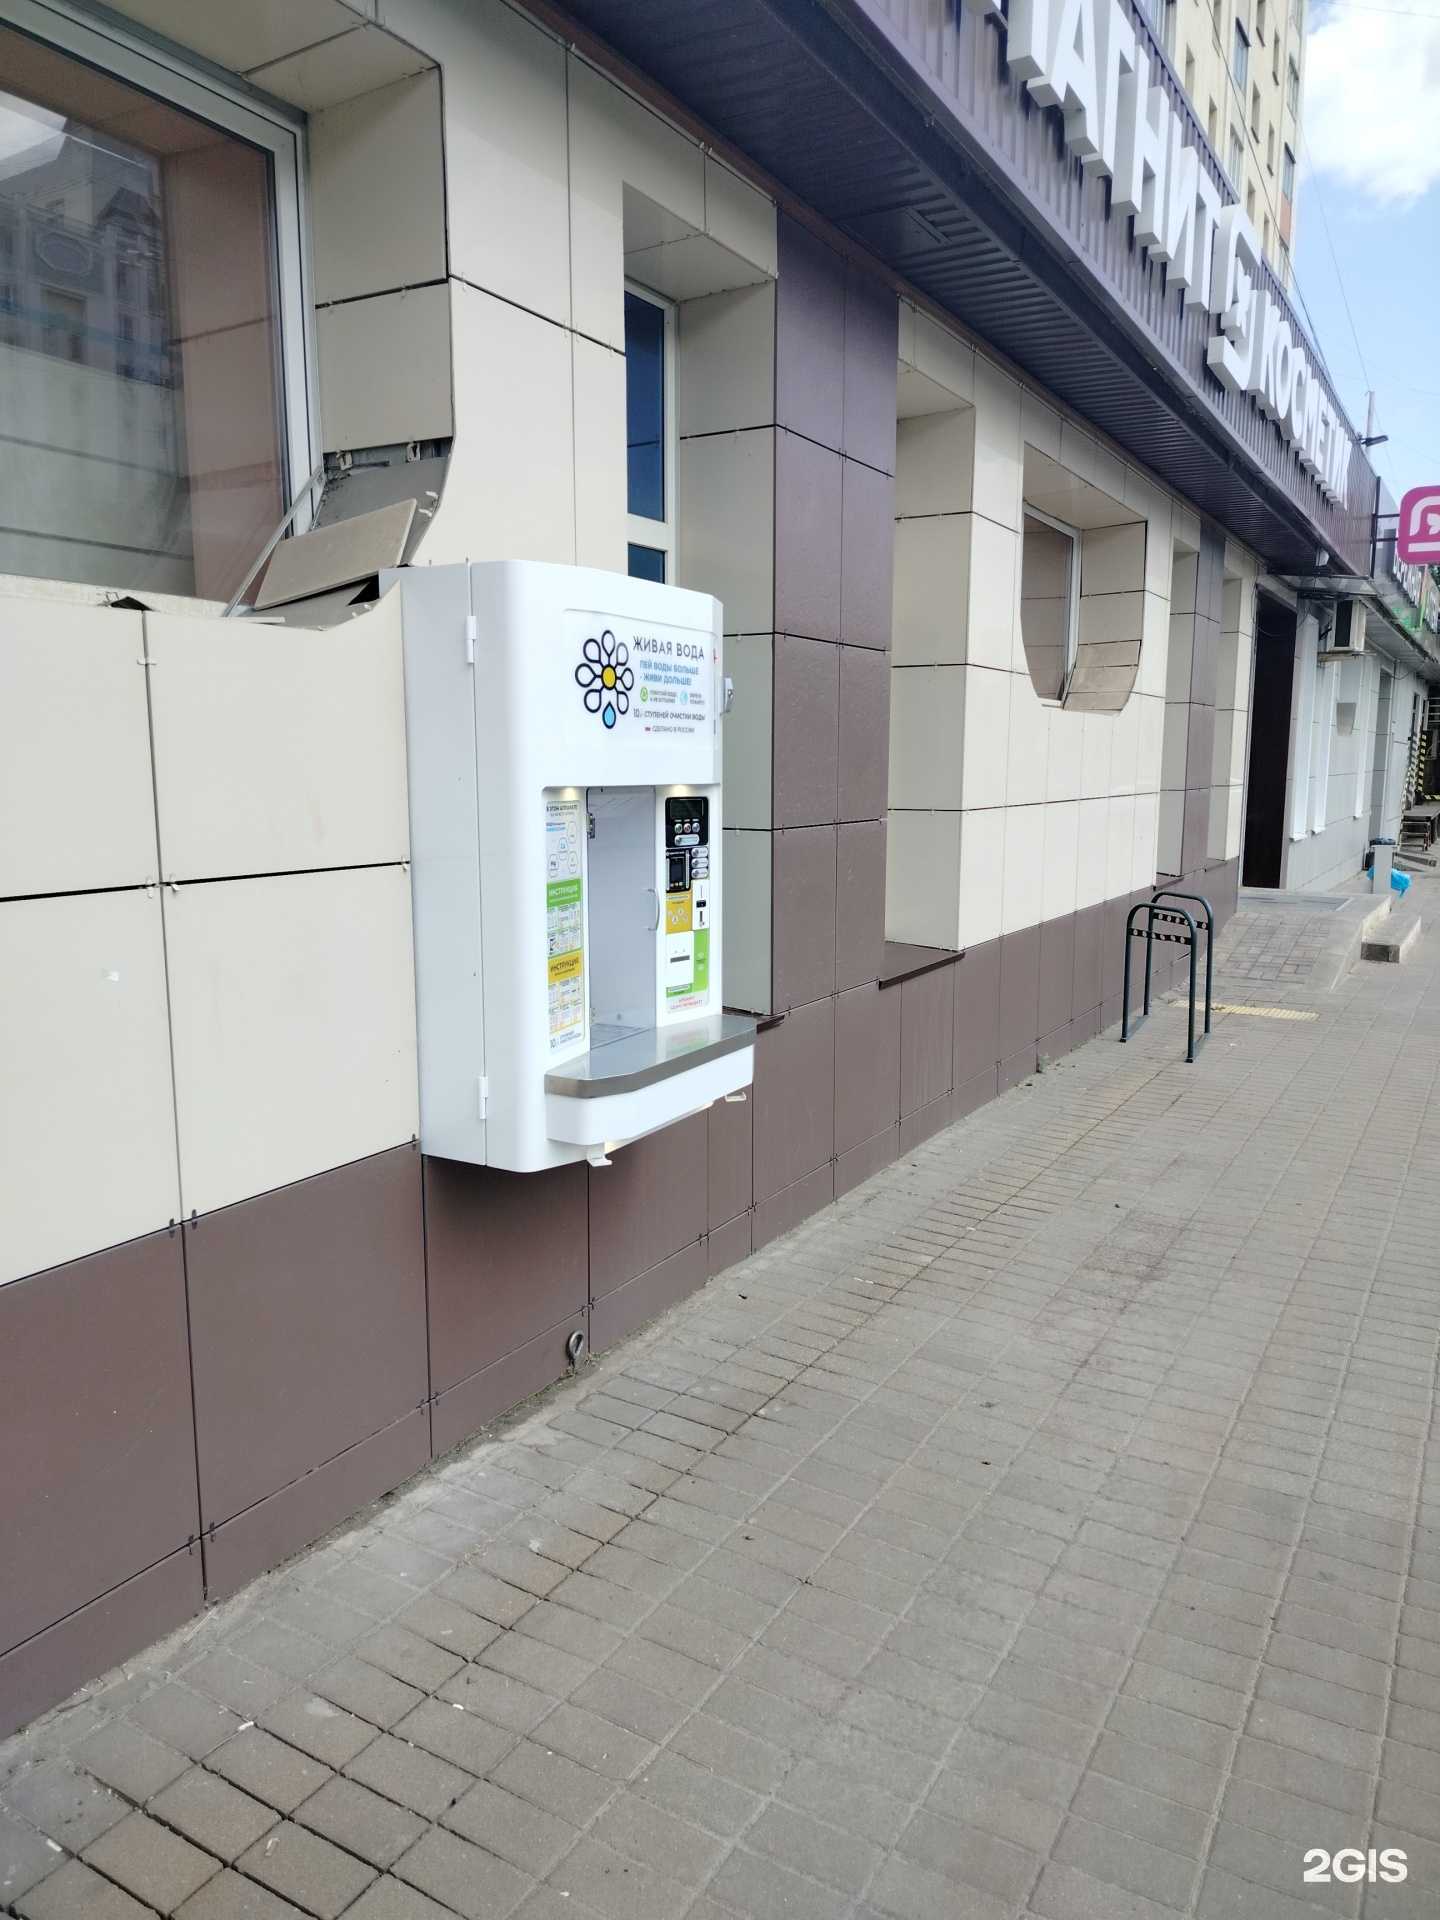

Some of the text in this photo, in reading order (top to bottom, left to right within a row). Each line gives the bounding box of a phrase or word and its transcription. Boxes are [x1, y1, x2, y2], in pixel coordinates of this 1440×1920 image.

[990, 0, 1222, 312] АГНИТ
[632, 635, 705, 660] ЖИВАЯ ВОДА
[640, 659, 699, 675] ПЕЙ ВОДЫ БОЛЬШЕ
[643, 673, 662, 682] ЖИВИ
